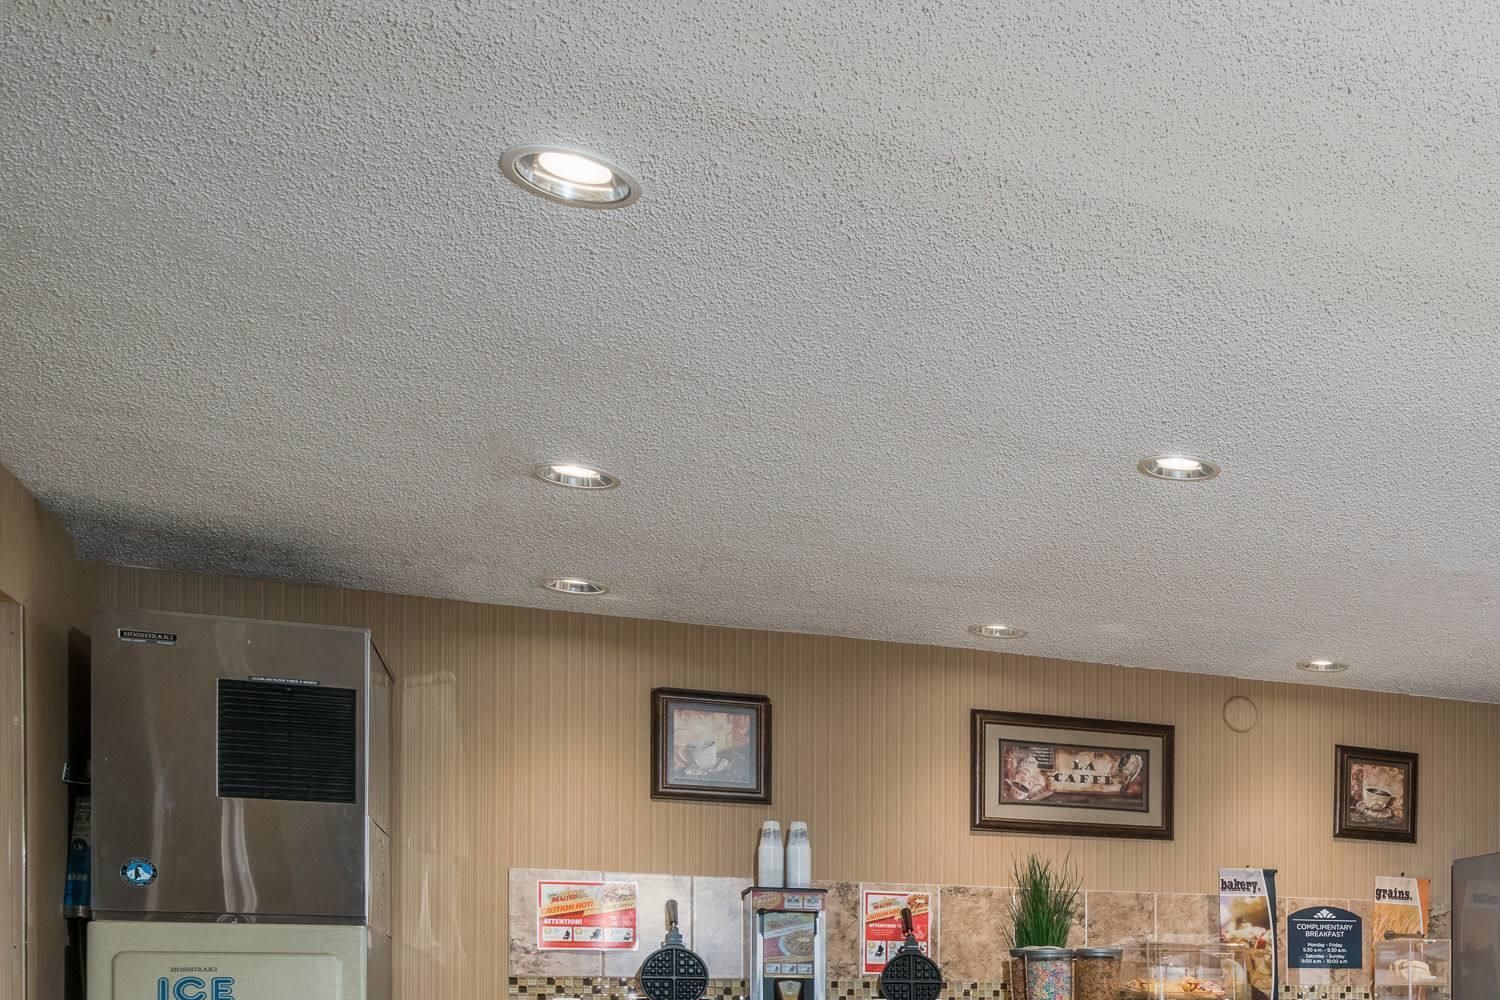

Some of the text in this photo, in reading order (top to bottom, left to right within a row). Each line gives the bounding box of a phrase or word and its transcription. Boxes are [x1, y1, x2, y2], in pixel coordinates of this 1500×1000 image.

[1071, 760, 1096, 771] LA
[1220, 879, 1261, 894] bakery.
[1375, 888, 1413, 901] grains.
